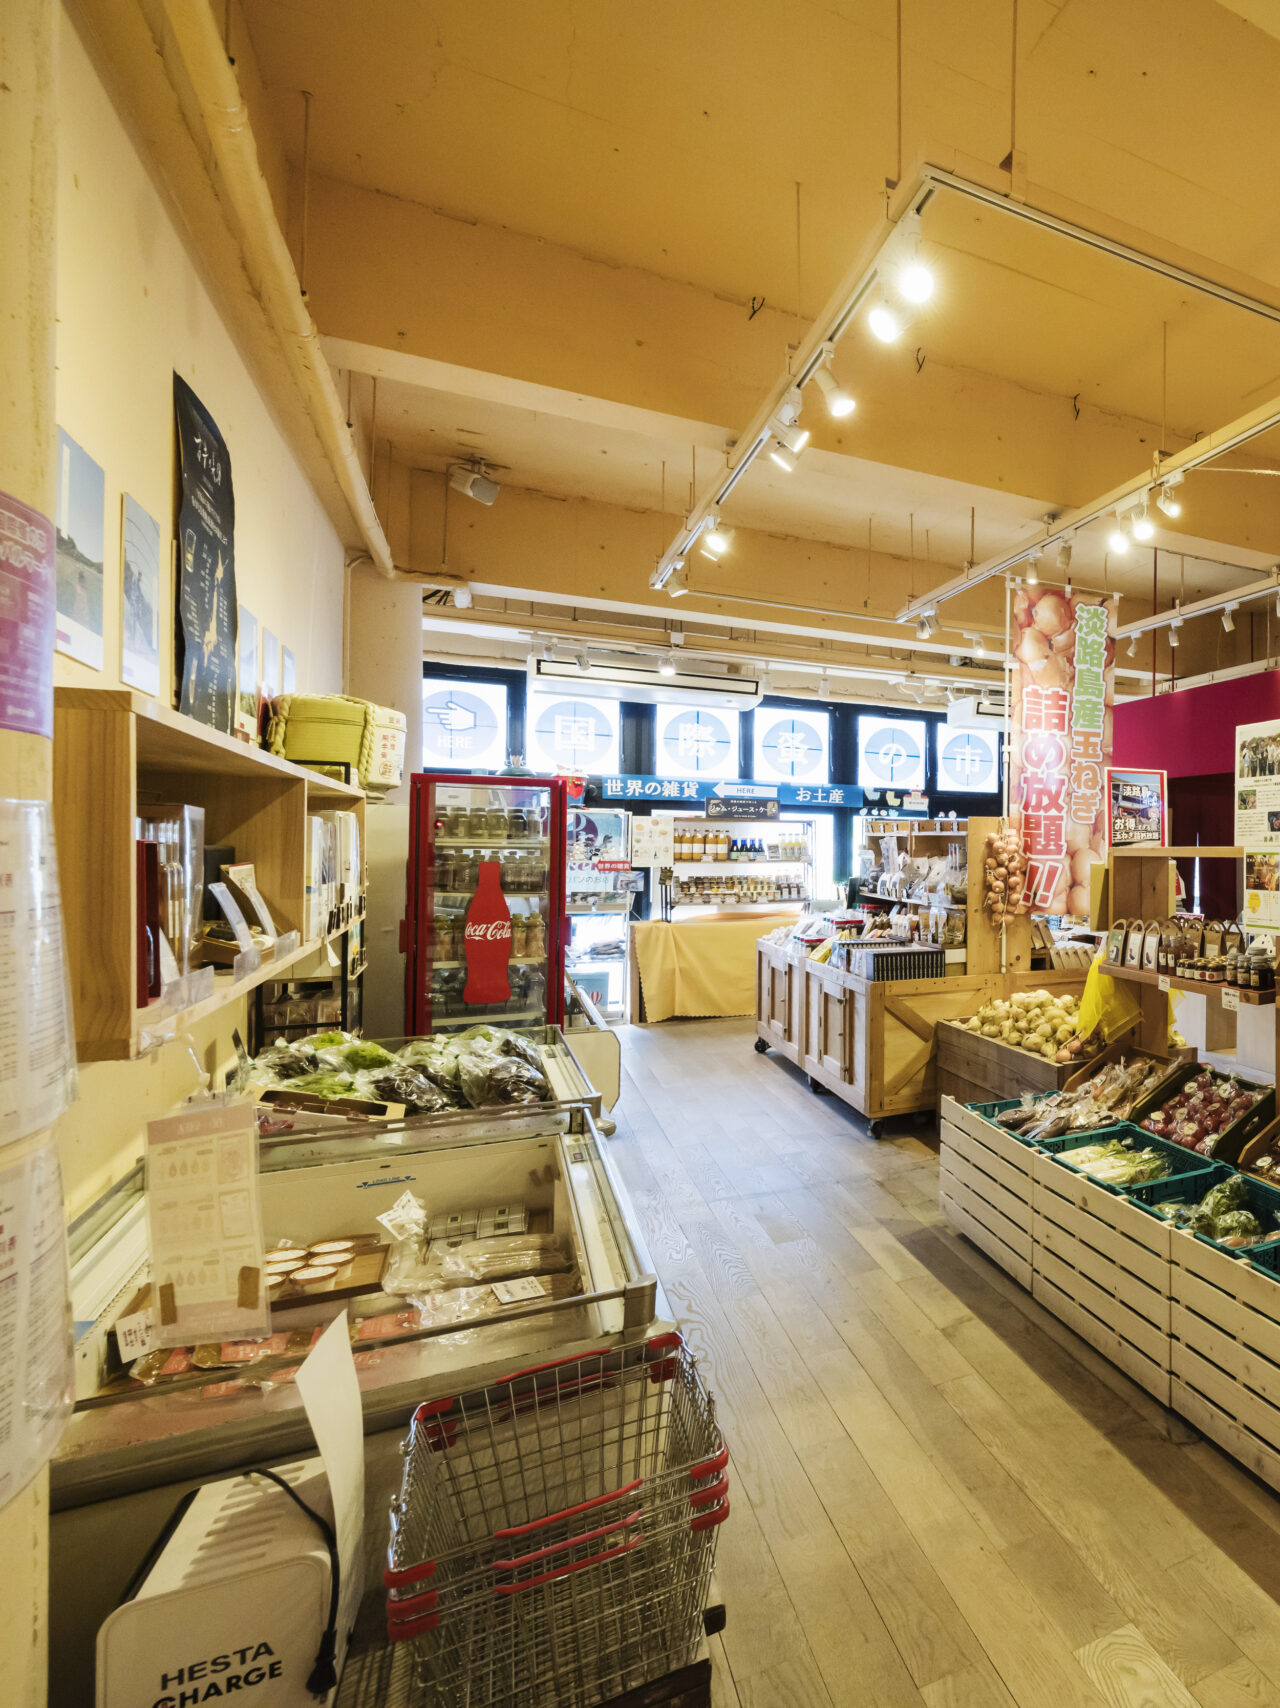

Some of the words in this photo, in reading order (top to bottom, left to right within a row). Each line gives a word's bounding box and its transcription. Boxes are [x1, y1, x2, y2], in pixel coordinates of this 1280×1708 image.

[1070, 604, 1109, 825] 淡路島産玉ねぎ
[437, 735, 473, 749] HERE
[878, 742, 907, 768] の
[952, 744, 984, 775] 市
[604, 778, 700, 799] 世界の雑貨
[736, 787, 755, 795] HERE
[795, 787, 844, 804] お土産
[160, 1641, 276, 1691] HESTA
[151, 1660, 284, 1708] CHARGE
